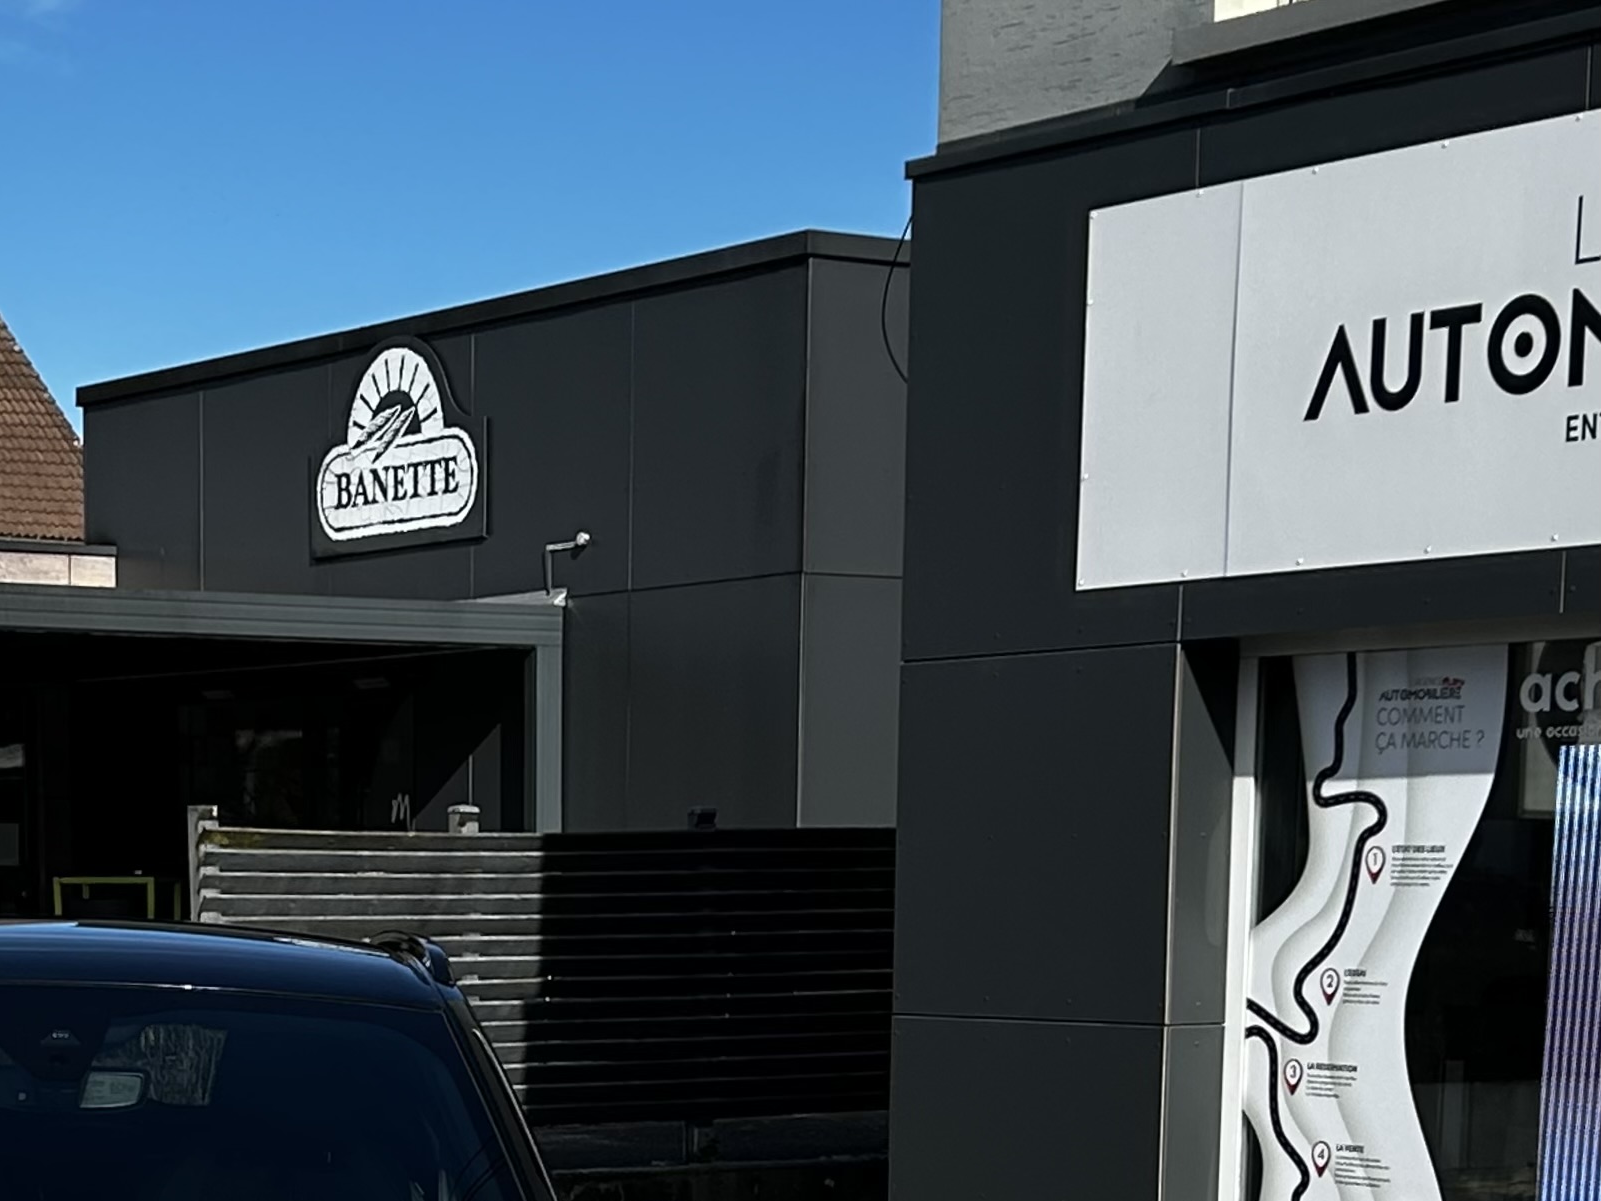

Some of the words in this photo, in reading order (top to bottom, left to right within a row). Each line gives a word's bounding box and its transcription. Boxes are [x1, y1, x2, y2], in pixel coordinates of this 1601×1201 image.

[1565, 411, 1601, 443] EN
[335, 456, 460, 510] BANETTE
[1376, 704, 1465, 726] COMMENT
[1375, 731, 1397, 755] ÇA
[1399, 729, 1471, 750] MARCHE
[1476, 729, 1486, 748] ?
